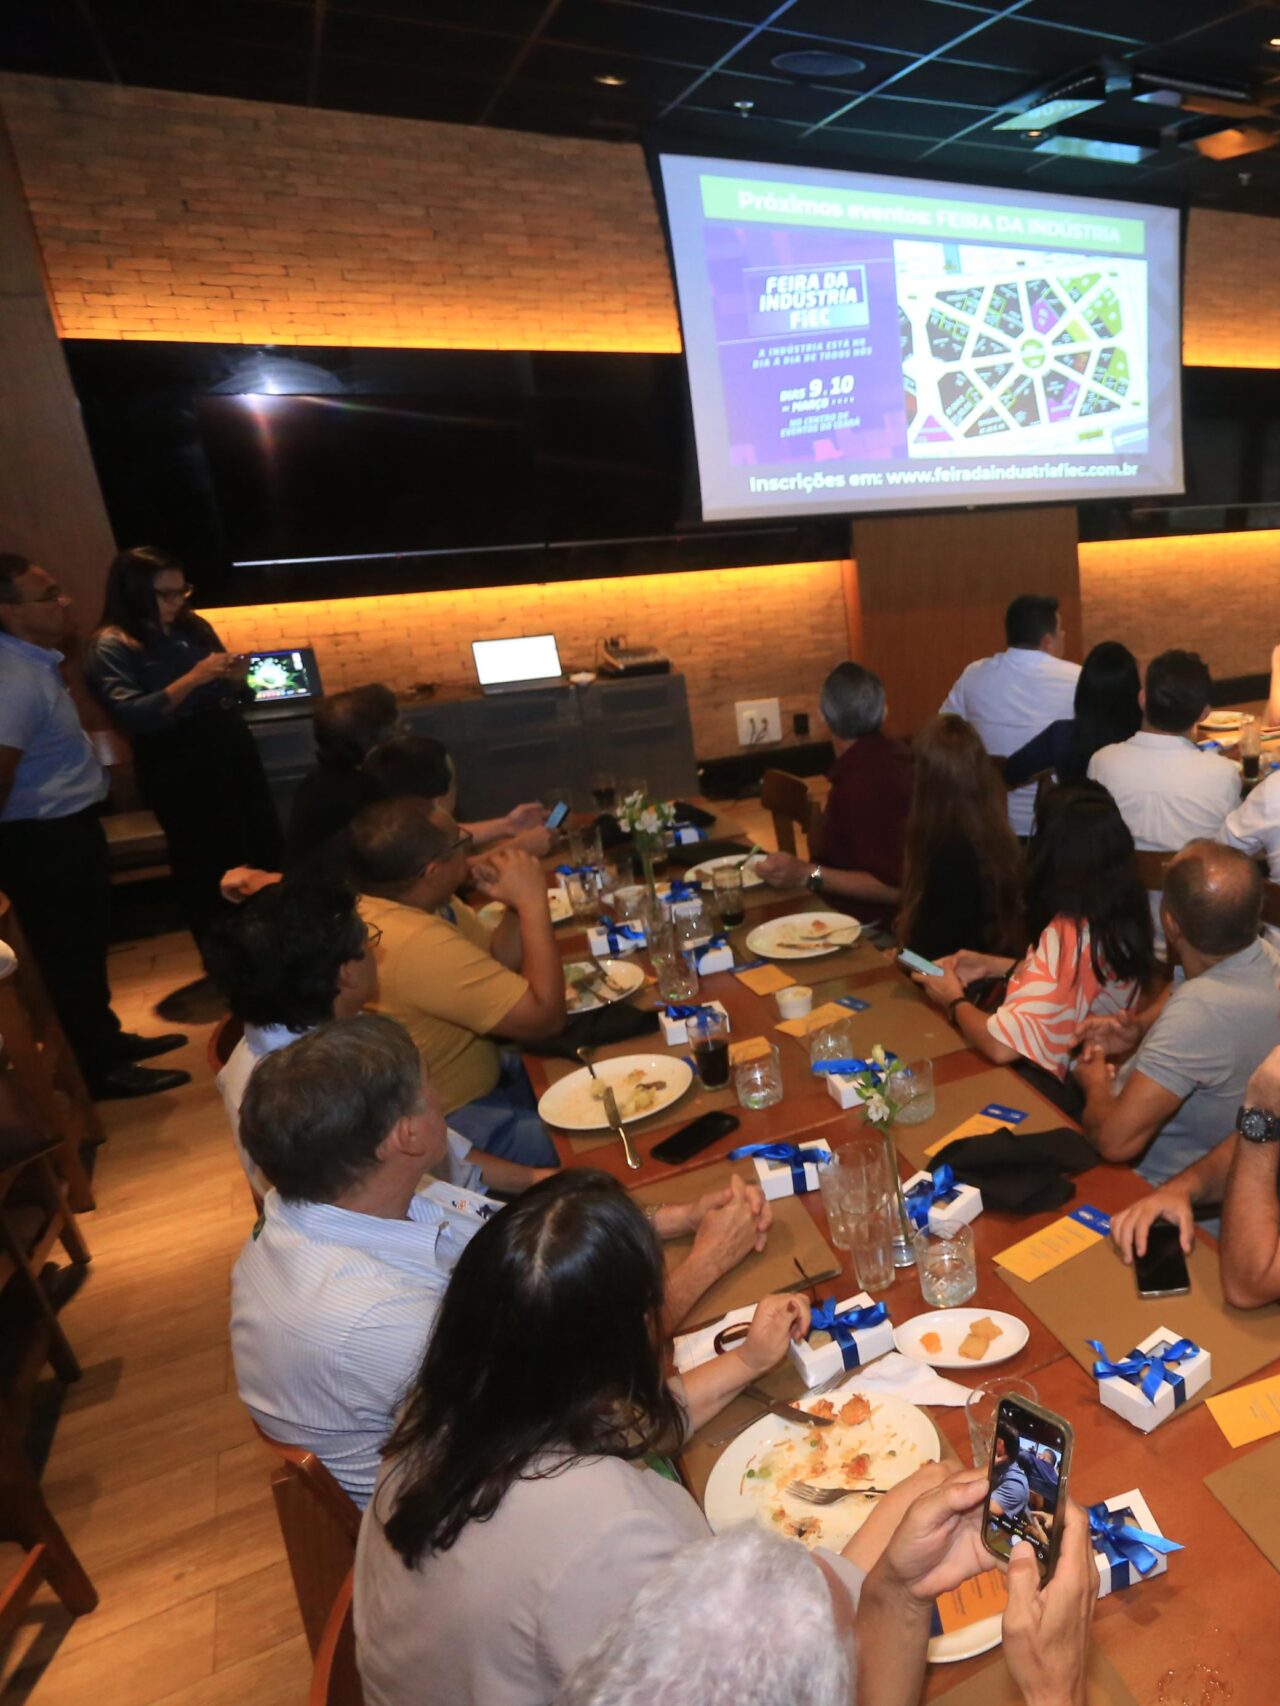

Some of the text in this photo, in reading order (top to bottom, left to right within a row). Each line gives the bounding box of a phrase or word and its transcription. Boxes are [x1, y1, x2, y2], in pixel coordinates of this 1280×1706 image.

[737, 191, 1121, 243] Próximos eventos: FEIRA DA INDÚSTRIA
[765, 271, 848, 294] FEIRA DA
[750, 461, 1140, 493] Inscrições em: www.feiradaindustriafiec.com.br
